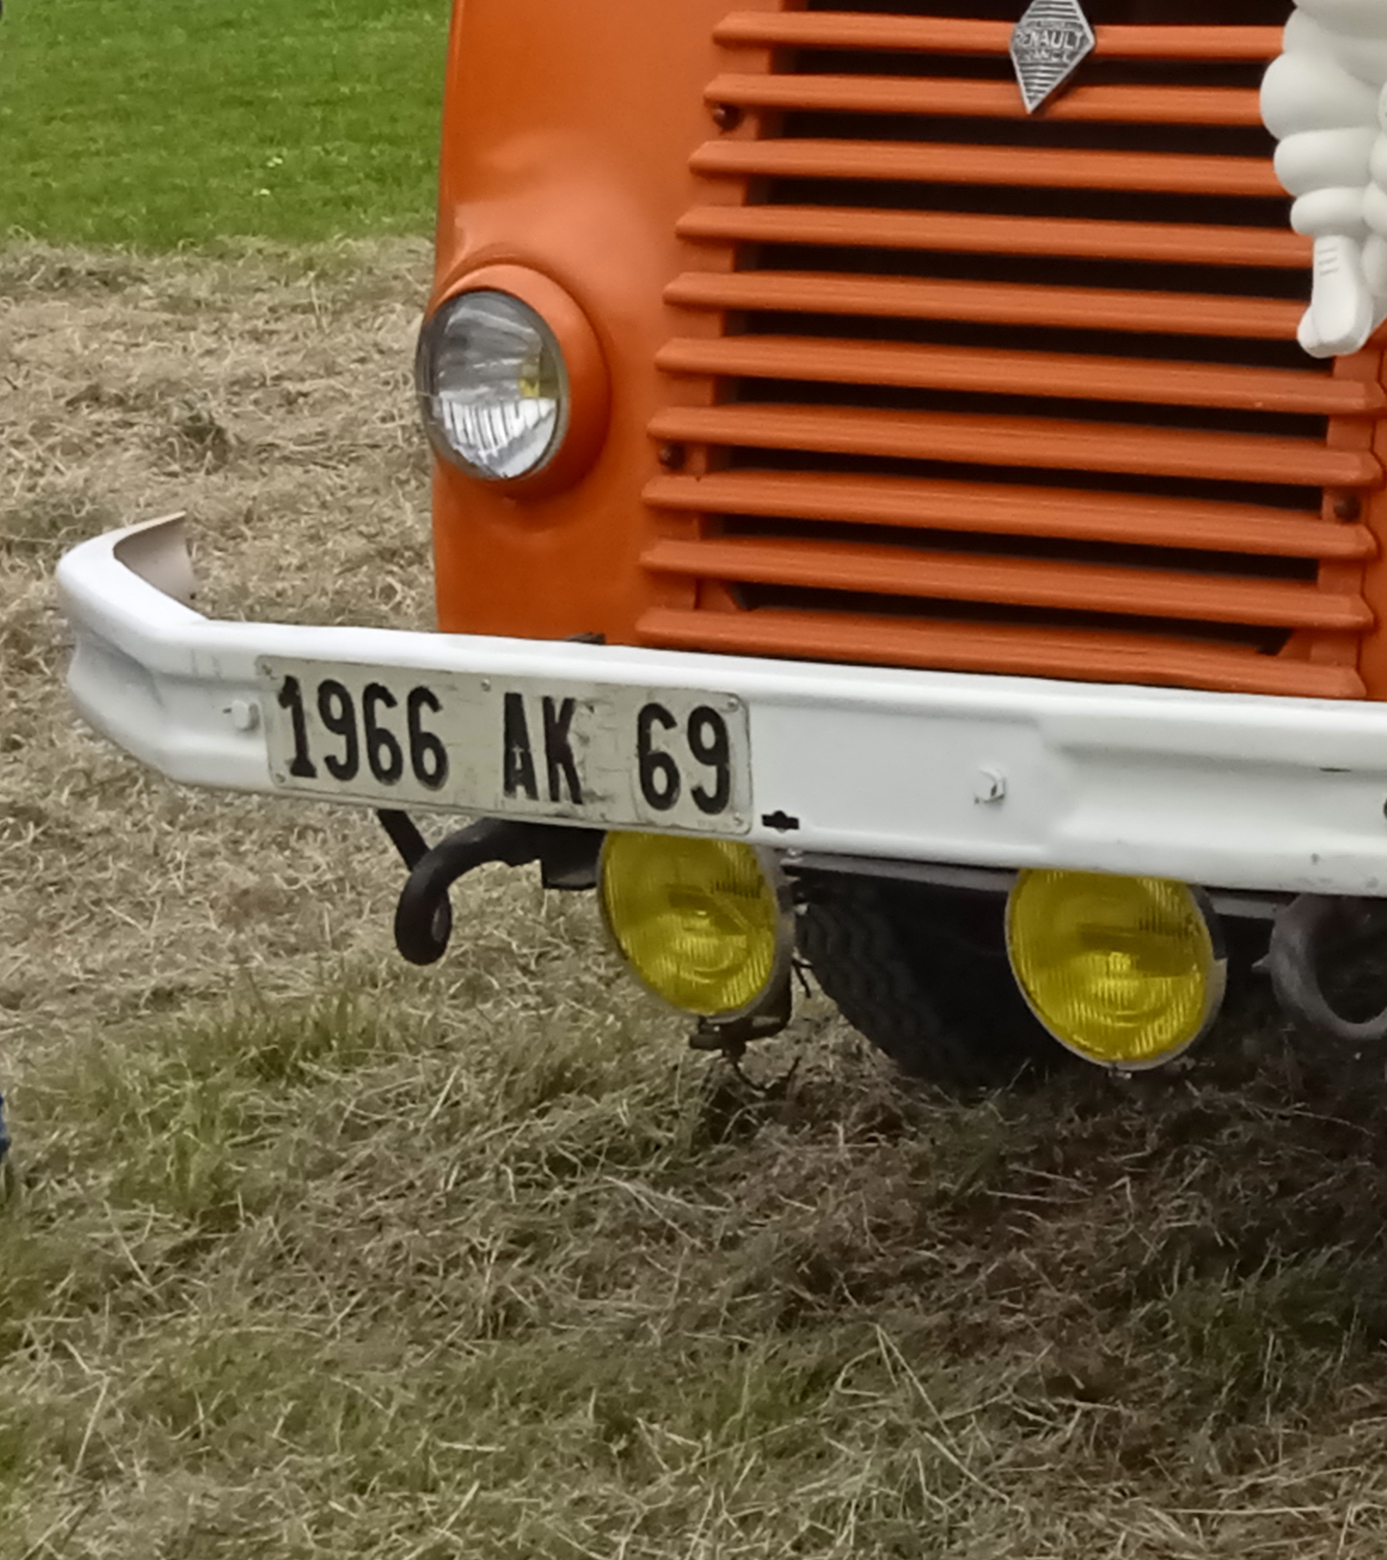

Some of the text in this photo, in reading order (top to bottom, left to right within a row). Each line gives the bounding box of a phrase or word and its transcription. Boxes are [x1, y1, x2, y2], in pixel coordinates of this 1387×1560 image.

[276, 673, 732, 815] 1966 AK 69
